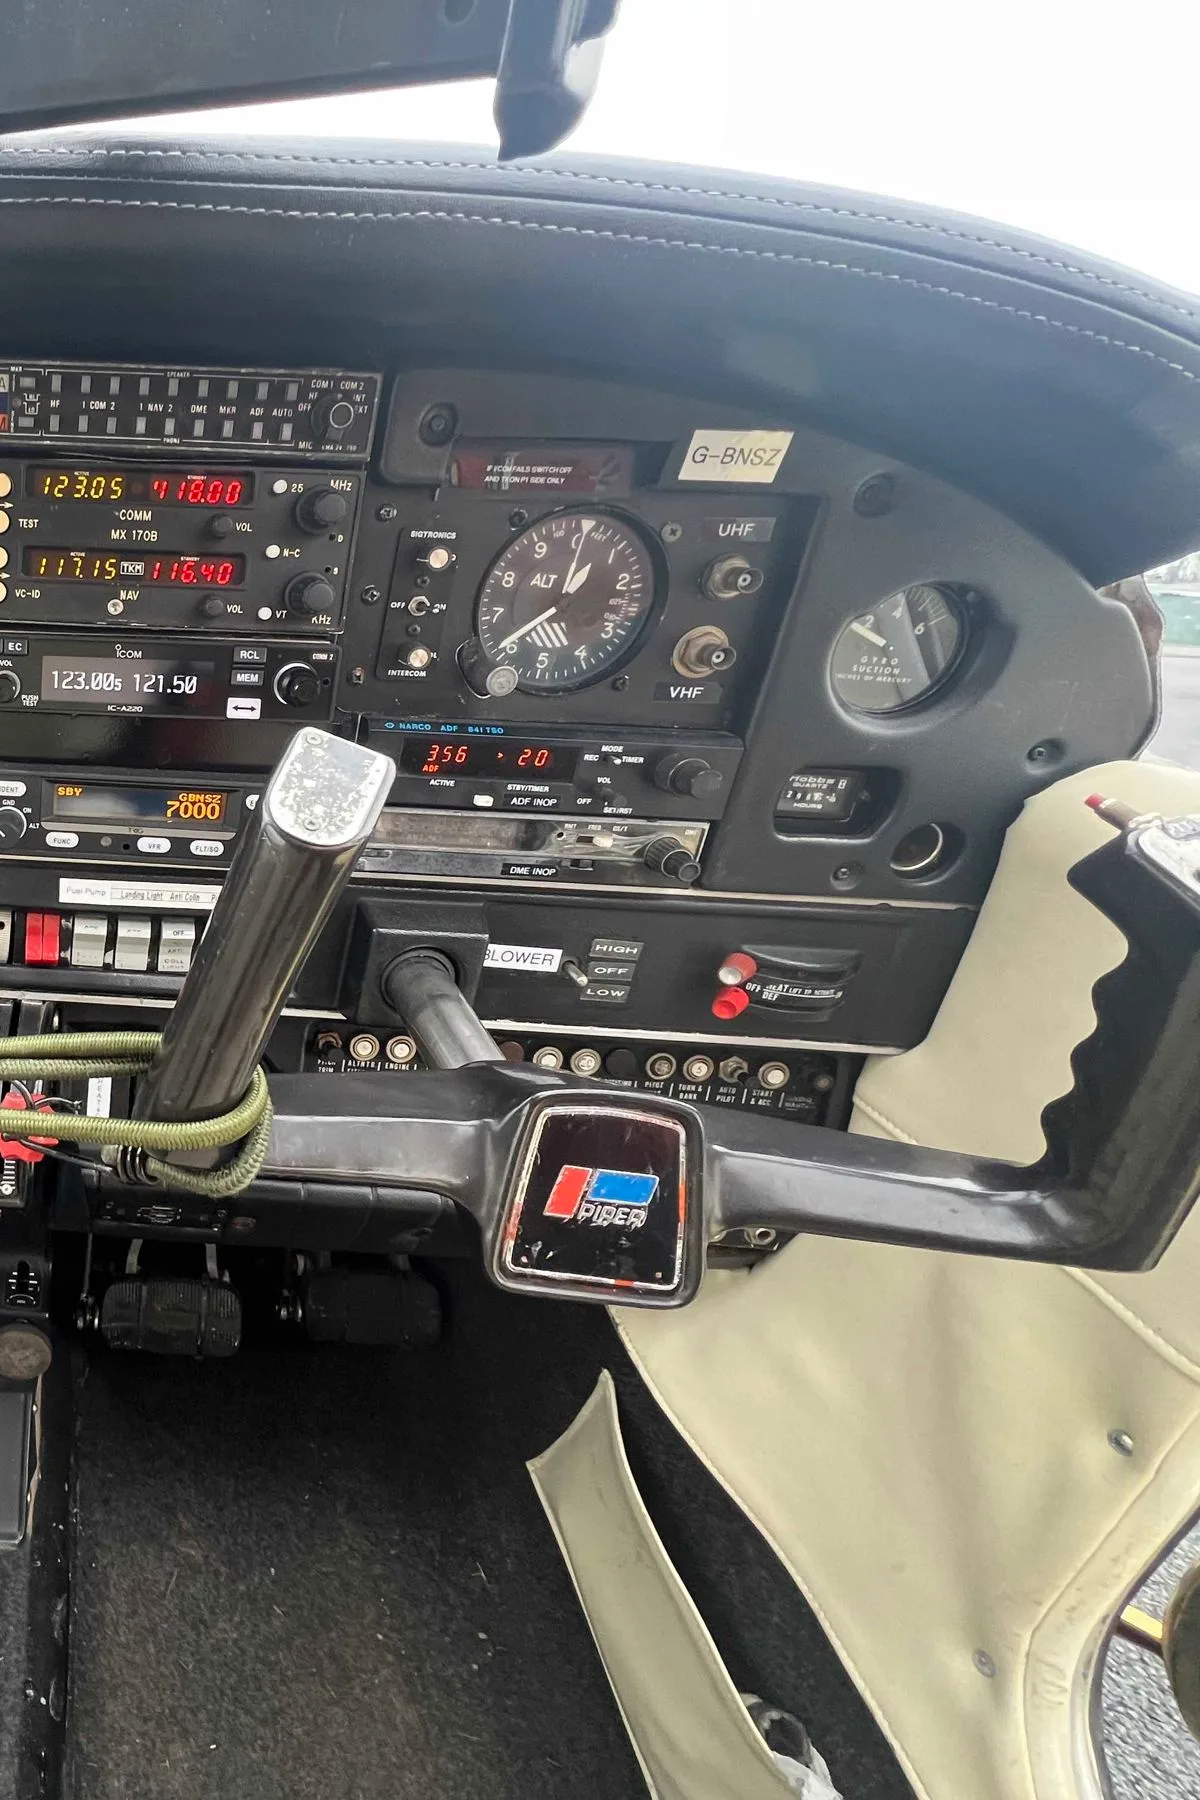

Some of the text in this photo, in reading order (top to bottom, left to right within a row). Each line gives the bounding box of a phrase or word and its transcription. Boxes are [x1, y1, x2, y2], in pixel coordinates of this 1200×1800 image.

[90, 401, 106, 410] COM
[147, 403, 164, 412] NAV
[190, 404, 208, 414] DME
[218, 406, 236, 414] MKR
[249, 408, 265, 416] ADF
[272, 408, 294, 418] AUTO
[692, 446, 783, 466] G-BNSZ
[43, 476, 123, 500] 123.05
[291, 484, 304, 493] 25
[330, 479, 353, 491] MHz
[119, 509, 152, 522] COMM
[18, 518, 40, 529] TEST
[236, 522, 253, 532] VOL
[410, 530, 457, 540] SIGTRONICS
[718, 523, 756, 537] UHF
[111, 529, 158, 542] MX 170B
[534, 542, 548, 558] 9
[40, 558, 117, 580] 117.15
[122, 564, 143, 573] TKM
[152, 562, 234, 585] 116.40
[502, 571, 516, 588] 8
[530, 572, 558, 588] ALT
[616, 573, 630, 590] 2
[15, 588, 41, 598] VC-ID
[120, 590, 140, 600] NAV
[226, 604, 244, 614] VOL
[492, 608, 504, 624] 7
[600, 622, 614, 639] 3
[8, 642, 22, 652] EC
[240, 650, 260, 660] RCL
[0, 659, 13, 667] VOL
[536, 652, 549, 669] 5
[860, 655, 899, 666] GYRO
[388, 670, 426, 678] INTERCOM
[852, 664, 901, 675] SUCTION
[236, 673, 260, 682] MEM
[133, 673, 198, 694] 121.50
[669, 686, 704, 699] VHF
[107, 704, 144, 712] IC-A220
[399, 722, 432, 731] NARCO
[601, 744, 624, 754] MODE
[427, 744, 550, 768] 356 20
[584, 753, 600, 762] REC
[622, 756, 646, 764] TIMER
[422, 764, 440, 773] ADF
[429, 778, 456, 788] ACTIVE
[596, 776, 612, 784] VOL
[789, 775, 836, 784] Hobbs
[0, 786, 19, 794] IDENT
[56, 786, 82, 797] SBY
[506, 784, 550, 793] STBY/TIMER
[178, 792, 222, 804] GBNSZ
[510, 796, 558, 807] ADF INOP
[576, 797, 593, 806] OFF
[166, 800, 220, 820] 7000
[602, 806, 633, 814] SET/RST
[52, 837, 72, 846] FUNC
[148, 843, 162, 851] VFR
[510, 866, 556, 876] DME INOP
[66, 886, 106, 897] Fuel Pump
[120, 890, 145, 901] Landing
[595, 944, 638, 954] HIGH
[594, 968, 629, 976] OFF
[745, 982, 761, 992] OFF
[586, 988, 626, 997] LOW
[762, 991, 779, 1001] DEF
[385, 1062, 410, 1070] ENGINE
[720, 1086, 736, 1094] AUTO
[752, 1089, 774, 1098] START
[716, 1095, 736, 1104] PILOT
[577, 1202, 647, 1228] PIPER
